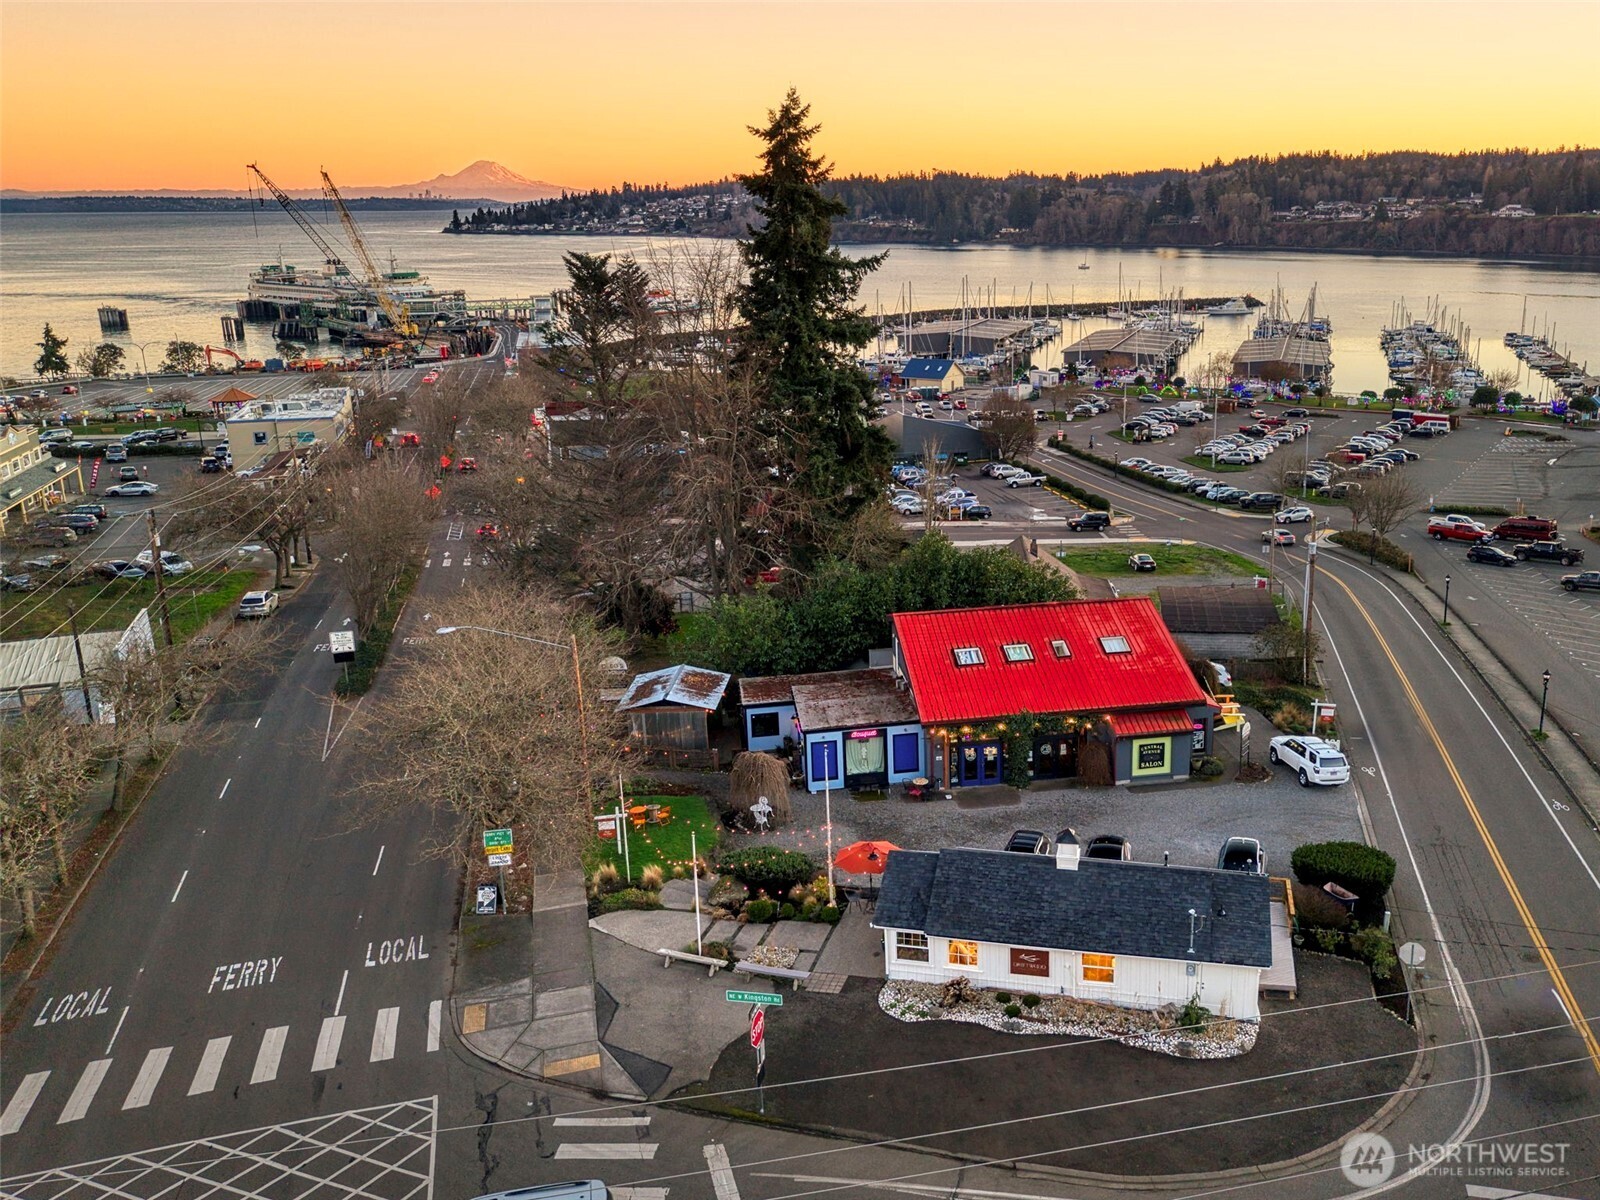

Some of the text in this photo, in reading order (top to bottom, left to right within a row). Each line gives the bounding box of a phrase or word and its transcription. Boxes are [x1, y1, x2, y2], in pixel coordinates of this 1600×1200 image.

[851, 730, 877, 738] Bouquet
[1141, 744, 1163, 752] CENTRAL
[364, 935, 430, 967] LOCAL
[207, 956, 283, 994] FERRY
[32, 986, 112, 1027] LOCAL
[744, 994, 772, 1003] Kingston
[752, 1016, 764, 1042] STOP
